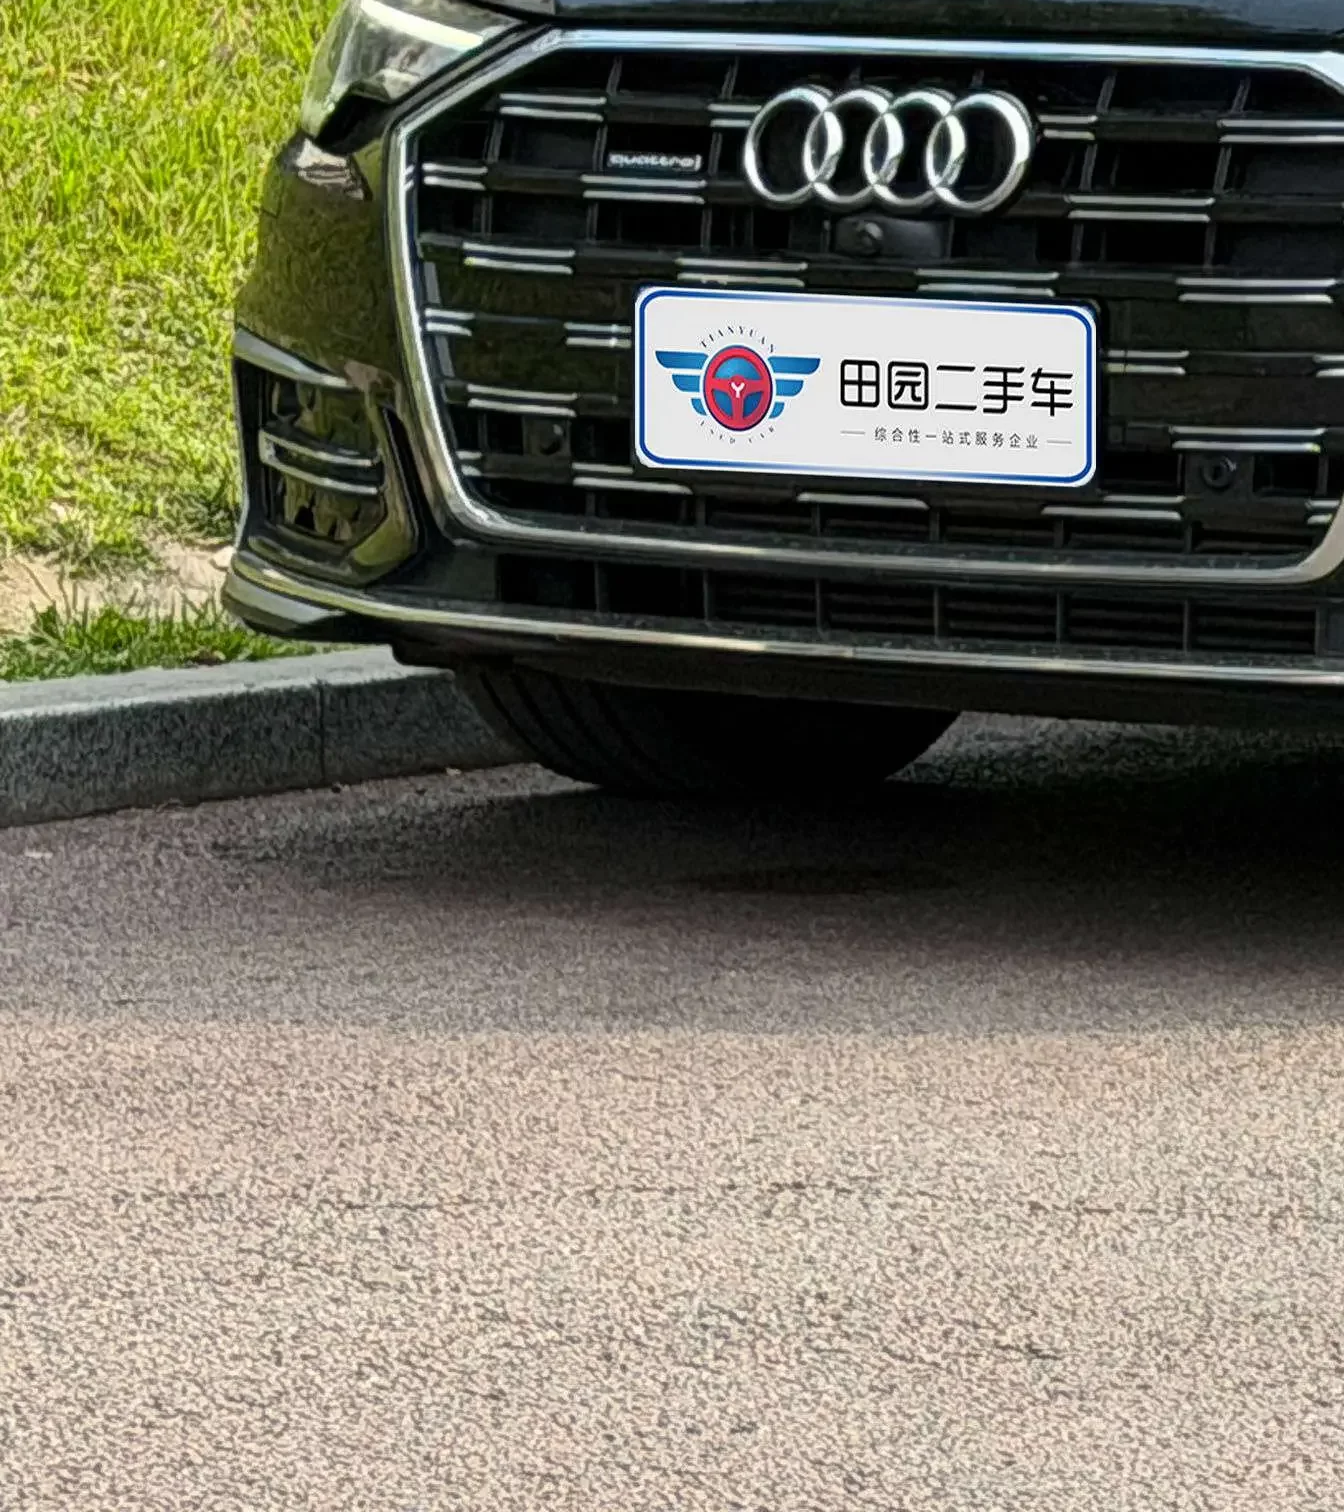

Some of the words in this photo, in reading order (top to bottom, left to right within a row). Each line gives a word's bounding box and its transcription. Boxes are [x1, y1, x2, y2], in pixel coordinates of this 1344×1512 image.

[730, 381, 746, 399] Y
[839, 358, 1074, 417] 田园二手车
[874, 425, 1039, 449] 综合性一站式服务企业
